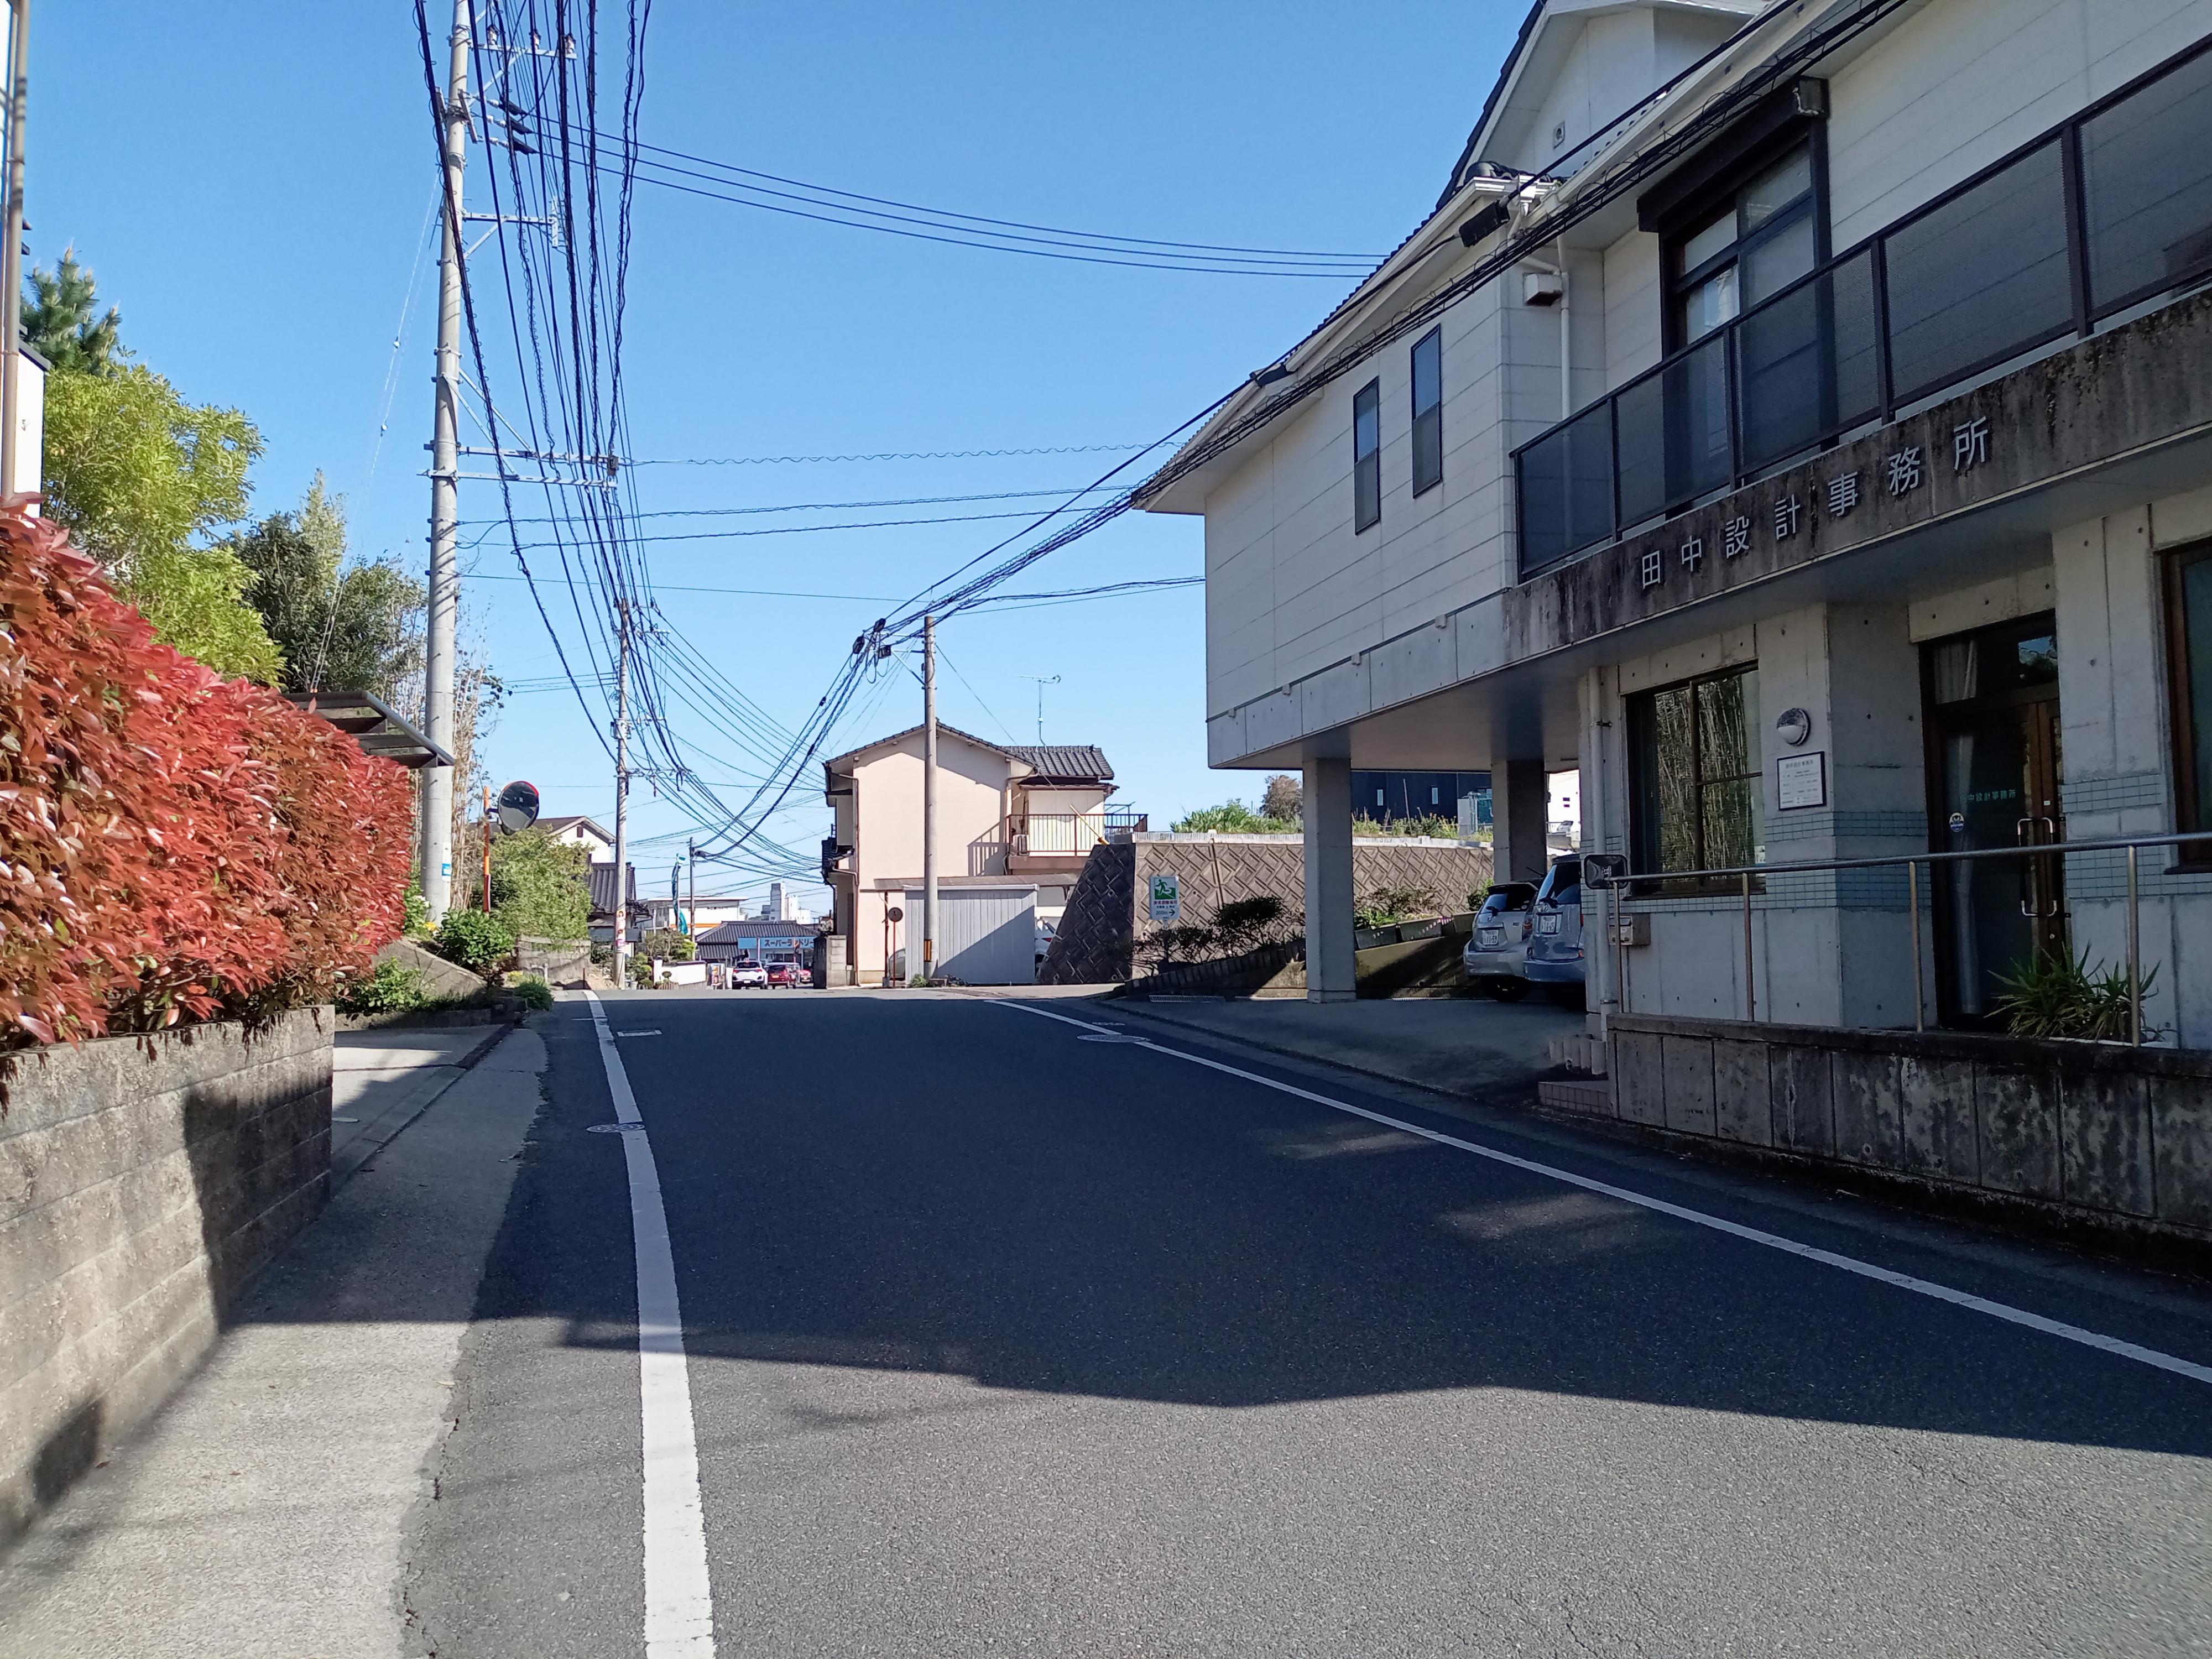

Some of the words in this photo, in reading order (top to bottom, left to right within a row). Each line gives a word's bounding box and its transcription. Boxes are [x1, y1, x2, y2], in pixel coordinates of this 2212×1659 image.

[1641, 416, 1989, 589] 田中設計事務所
